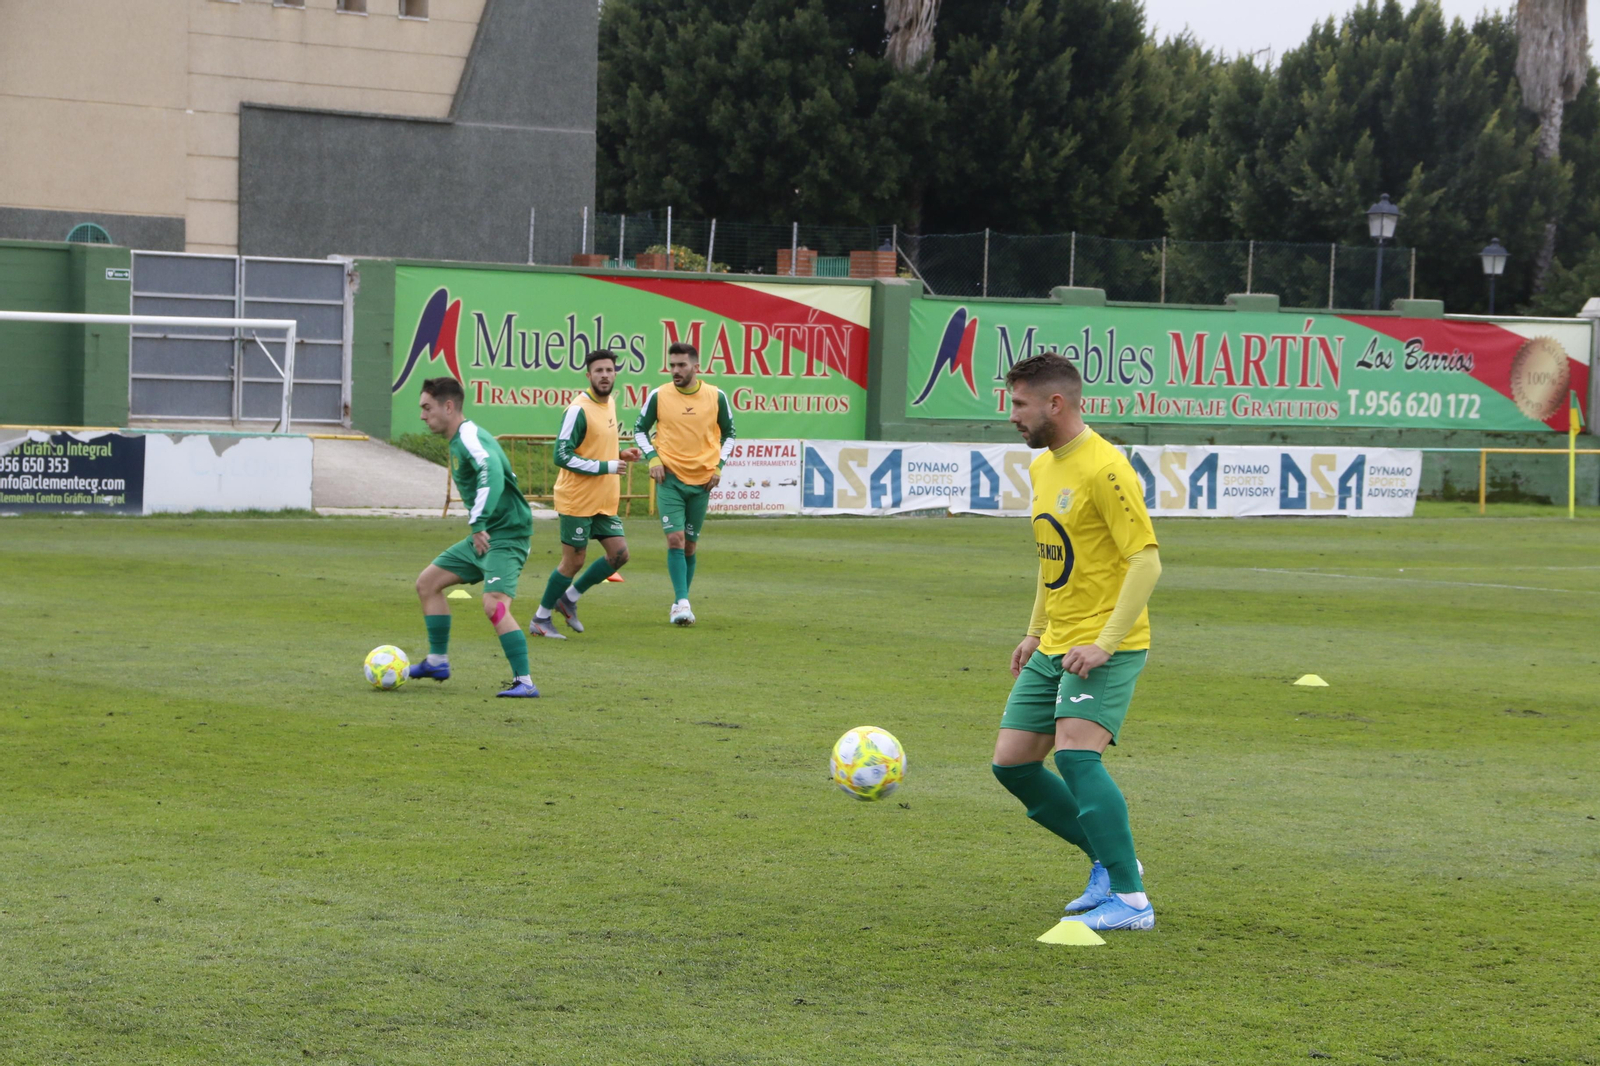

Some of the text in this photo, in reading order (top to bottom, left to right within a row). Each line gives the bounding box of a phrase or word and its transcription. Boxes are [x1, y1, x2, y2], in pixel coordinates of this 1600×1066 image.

[470, 308, 852, 377] Muebles MARTÍN
[1167, 319, 1344, 390] MARTÍN
[1356, 336, 1475, 373] Los Barrios
[1527, 371, 1557, 386] 100%
[732, 387, 850, 413] GRATUITOS
[1116, 398, 1129, 415] Y
[1134, 392, 1226, 418] MONTAJE
[1231, 395, 1340, 419] GRATUITOS
[1347, 389, 1481, 419] T.956 620 172
[66, 441, 112, 460] Integral
[747, 445, 797, 458] RENTAL
[22, 457, 44, 473] 650
[47, 457, 69, 473] 353
[908, 461, 959, 473] DYNAMO
[1223, 464, 1270, 475] DYNAMO
[1369, 465, 1413, 477] DYNAMO
[908, 473, 953, 485] SPORTS
[1223, 475, 1264, 486] SPORTS
[1368, 477, 1406, 487] SPORTS
[726, 491, 735, 499] 62
[738, 490, 747, 499] 06
[750, 490, 760, 499] 82
[908, 485, 966, 497] ADVISORY
[1222, 486, 1276, 498] ADVISORY
[1367, 487, 1416, 499] ADVISORY
[36, 492, 62, 504] Centro
[94, 493, 125, 507] Intgral
